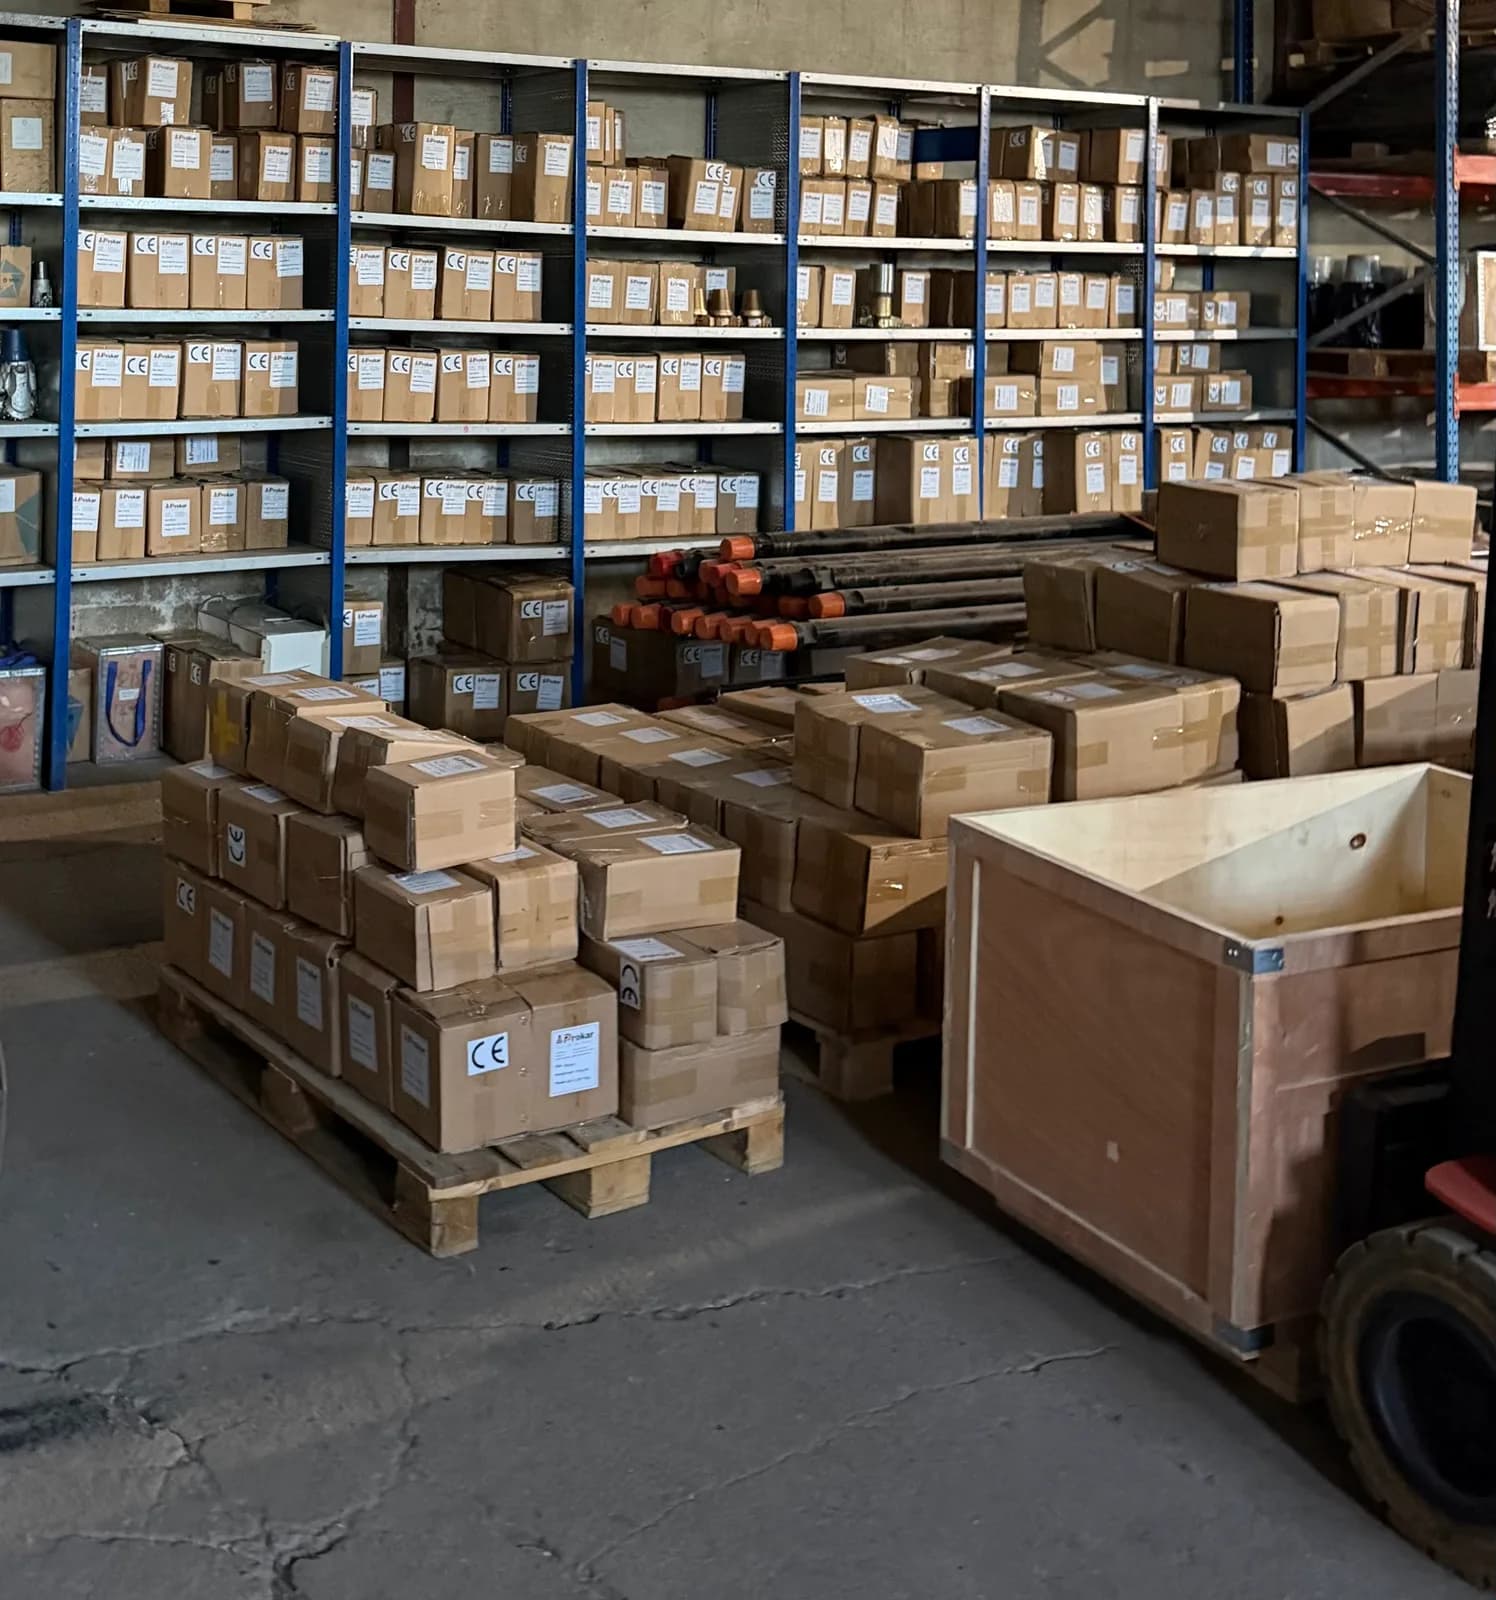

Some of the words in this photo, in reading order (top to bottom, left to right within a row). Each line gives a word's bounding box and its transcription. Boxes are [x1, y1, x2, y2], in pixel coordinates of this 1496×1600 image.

[707, 164, 723, 179] CE
[759, 173, 775, 187] CE
[136, 237, 156, 252] CE
[195, 238, 214, 253] CE
[253, 242, 272, 258] CE
[390, 254, 408, 269] CE
[447, 253, 465, 269] CE
[497, 256, 514, 271] CE
[190, 346, 209, 361] CE
[127, 358, 147, 373] CE
[249, 354, 267, 369] CE
[392, 356, 410, 371] CE
[443, 355, 462, 370] CE
[495, 359, 512, 373] CE
[618, 362, 633, 376] CE
[662, 360, 678, 373] CE
[705, 360, 720, 374] CE
[854, 446, 869, 460] CE
[381, 483, 399, 499] CE
[426, 481, 444, 497] CE
[467, 484, 484, 499] CE
[517, 485, 534, 499] CE
[602, 482, 618, 495] CE
[641, 481, 657, 494] CE
[680, 478, 695, 491] CE
[721, 478, 736, 491] CE
[523, 601, 542, 617] CE
[455, 675, 473, 691] CE
[519, 674, 537, 689] CE
[229, 826, 243, 861] CE
[178, 882, 193, 912] CE
[621, 964, 638, 1005] CE
[471, 1035, 506, 1069] CE
